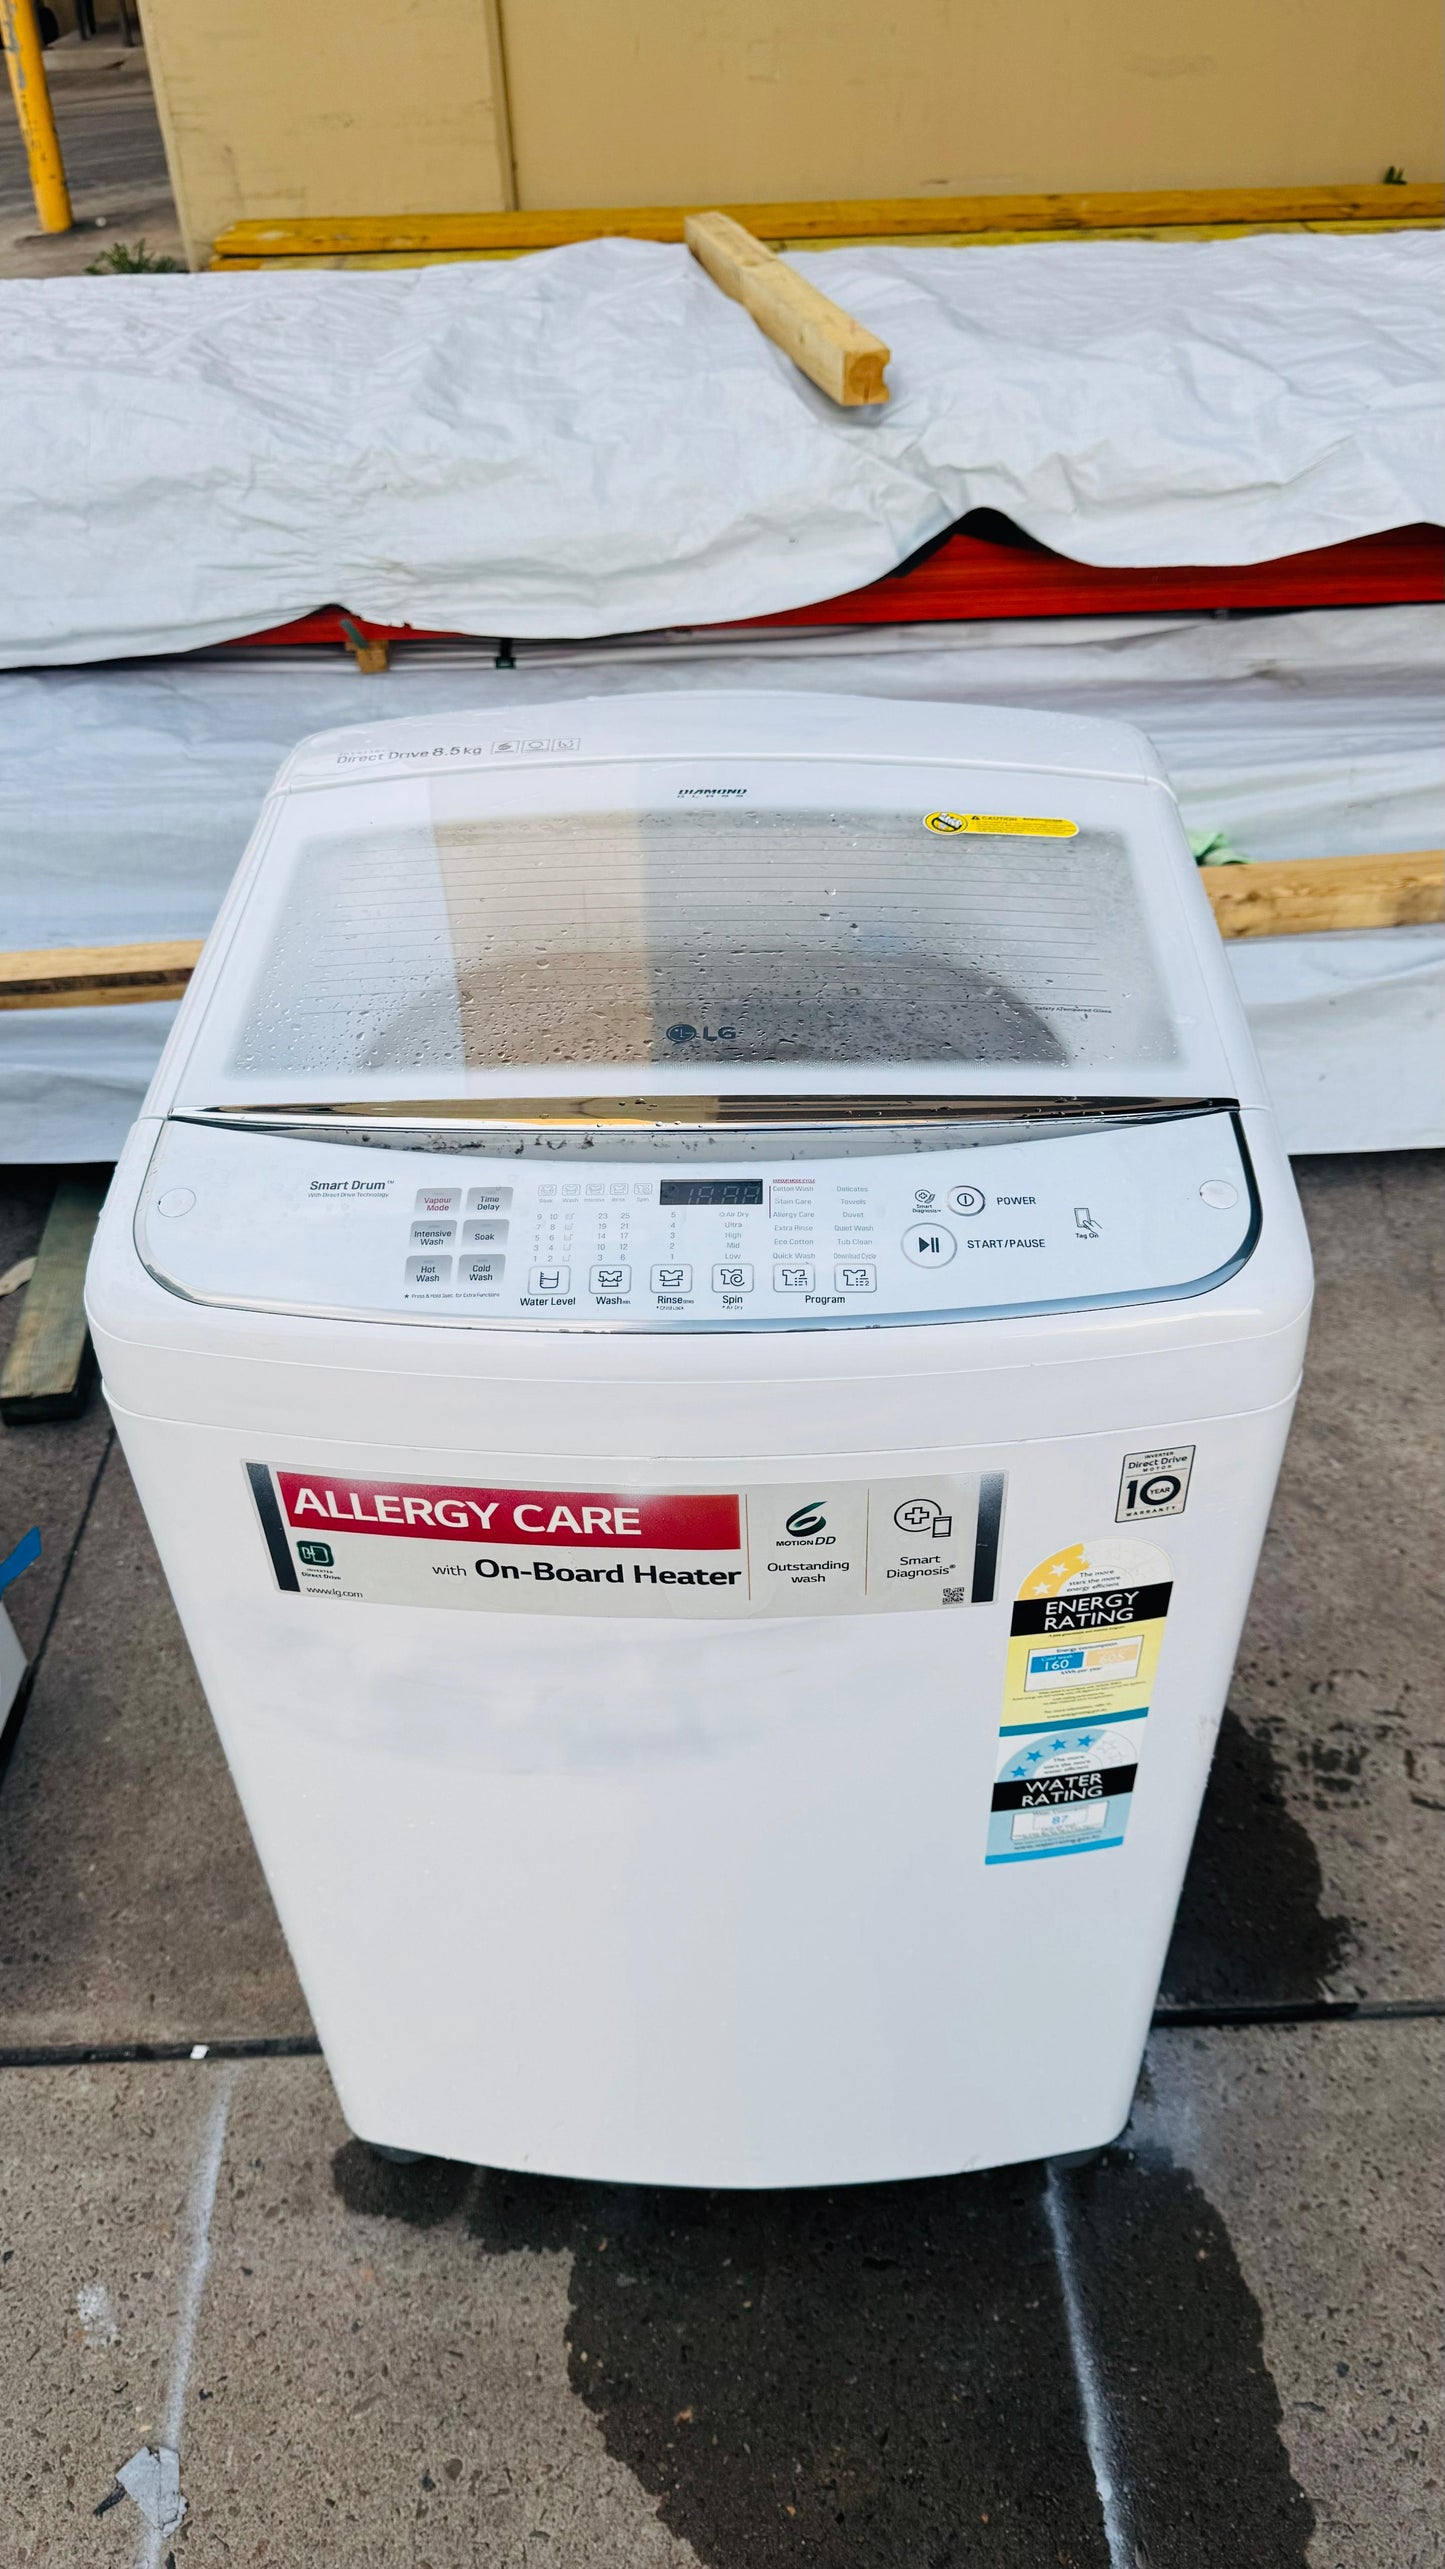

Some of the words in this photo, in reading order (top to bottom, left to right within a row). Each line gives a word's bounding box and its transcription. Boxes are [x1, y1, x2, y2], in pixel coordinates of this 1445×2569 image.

[337, 753, 384, 764] Direct
[388, 751, 429, 760] Drive
[432, 747, 460, 757] 8.5
[463, 747, 482, 755] kg
[703, 1026, 736, 1041] LG
[310, 1180, 348, 1190] Smart
[424, 1197, 452, 1205] Vapour
[480, 1195, 500, 1203] Time
[997, 1197, 1036, 1205] POWER
[477, 1203, 500, 1211] Delay
[537, 1213, 543, 1221] 9
[550, 1213, 558, 1221] 10
[598, 1212, 608, 1220] 23
[620, 1212, 630, 1220] 25
[671, 1211, 677, 1219] 5
[536, 1223, 542, 1231] 7
[550, 1223, 556, 1231] 8
[620, 1222, 629, 1230] 21
[414, 1230, 452, 1238] Intensive
[474, 1233, 495, 1241] Soak
[598, 1232, 606, 1240] 14
[620, 1232, 629, 1240] 17
[670, 1231, 676, 1239] 3
[597, 1243, 605, 1251] 10
[620, 1242, 628, 1251] 12
[669, 1242, 675, 1250] 2
[967, 1240, 1046, 1249] START/PAUSE
[597, 1253, 603, 1261] 3
[620, 1253, 626, 1261] 6
[420, 1265, 436, 1273] Hot
[472, 1264, 491, 1273] Cold
[416, 1274, 440, 1282] Wash
[469, 1273, 493, 1281] Wash
[520, 1298, 548, 1306] Water
[550, 1297, 576, 1306] Level
[596, 1297, 622, 1305] Wash
[657, 1296, 683, 1304] Rinse
[722, 1295, 743, 1305] Spin
[805, 1295, 846, 1305] Program
[1145, 1451, 1174, 1459] INVERTER
[1128, 1459, 1159, 1469] Direct
[1161, 1456, 1188, 1464] Drive
[1126, 1475, 1181, 1509] 10
[1150, 1487, 1171, 1495] YEAR
[294, 1488, 499, 1530] ALLERGY
[513, 1504, 642, 1535] CARE
[1126, 1506, 1176, 1517] WARRANTY
[900, 1555, 941, 1566] Smart
[767, 1560, 850, 1572] Outstanding
[433, 1562, 467, 1577] with
[475, 1558, 624, 1584] On-Board
[634, 1564, 741, 1585] Heater
[791, 1573, 826, 1583] wash
[306, 1587, 363, 1598] www.lg.com
[1046, 1591, 1140, 1615] ENERGY
[1044, 1608, 1134, 1631] RATING
[1044, 1659, 1069, 1671] 160
[1025, 1773, 1102, 1793] WATER
[1021, 1785, 1103, 1807] RATING
